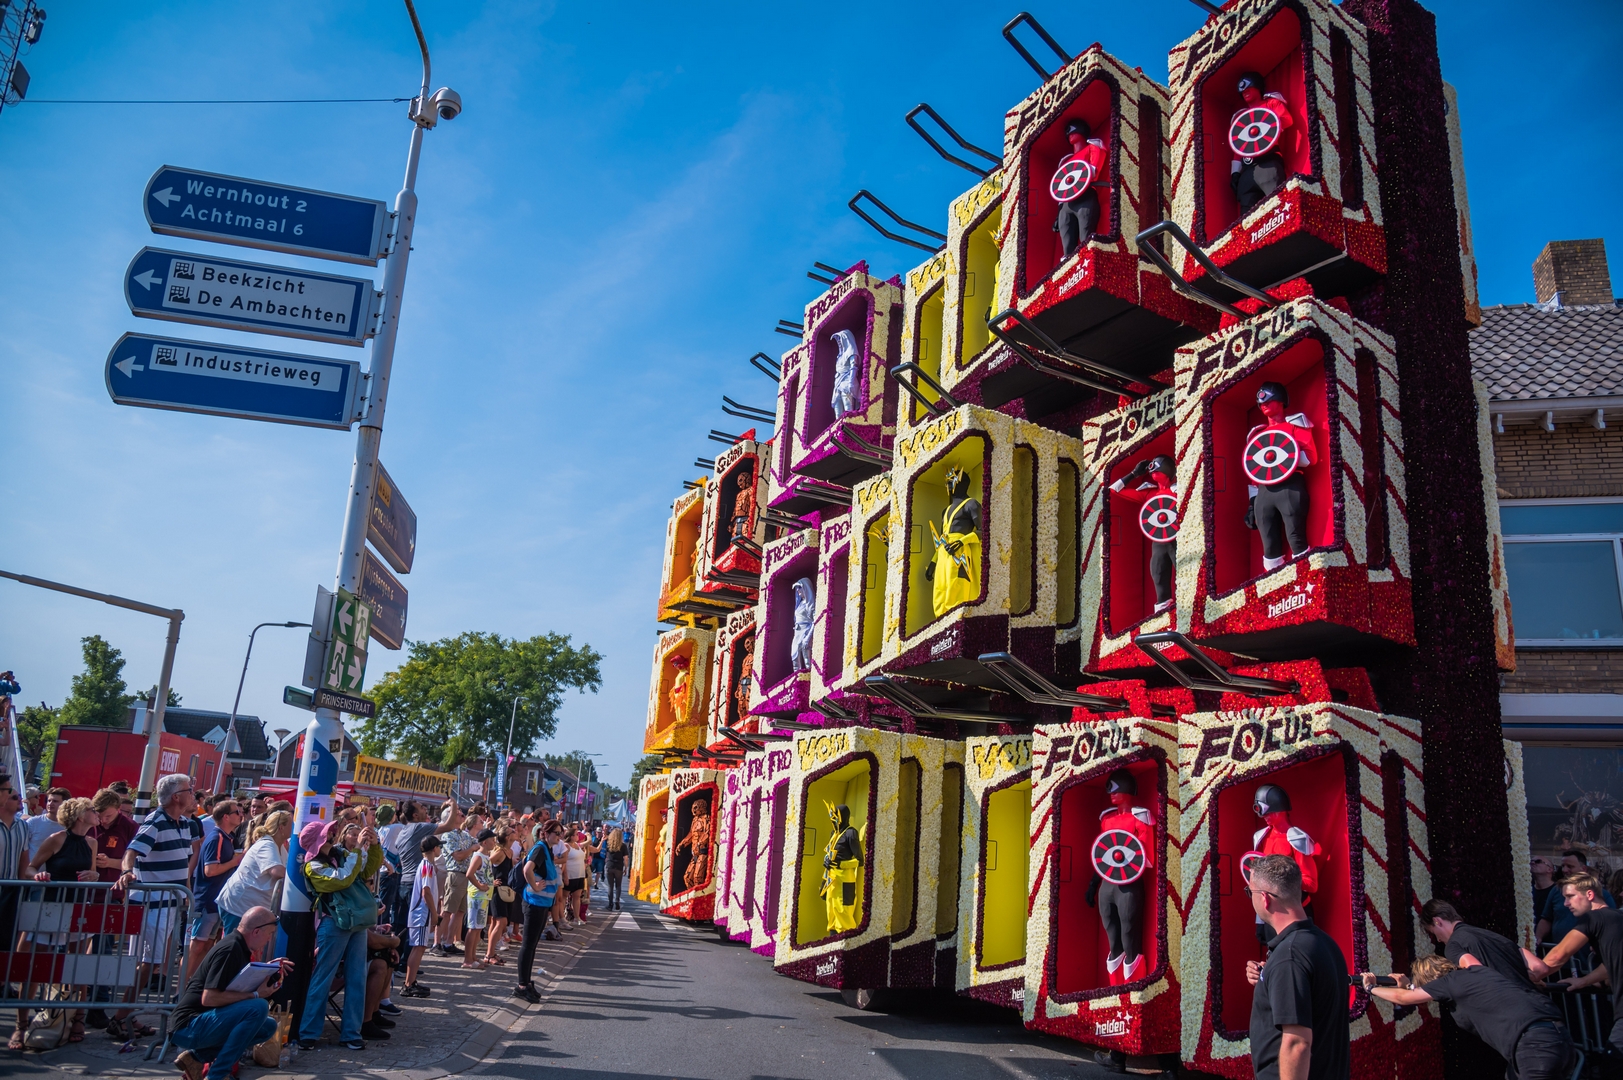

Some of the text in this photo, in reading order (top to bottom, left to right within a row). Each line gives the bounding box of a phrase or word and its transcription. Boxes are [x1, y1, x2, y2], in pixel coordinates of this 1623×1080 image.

[1012, 55, 1089, 148] FOCUS
[187, 179, 307, 212] Wernhout 2
[180, 203, 303, 236] Achtmaal 6
[1250, 212, 1285, 243] helden
[202, 266, 305, 295] Beekzicht
[198, 290, 346, 325] De Ambachten
[1187, 306, 1295, 396] FOCUS
[184, 352, 321, 386] Industrieweg
[1268, 593, 1306, 618] helden
[321, 693, 371, 715] PRINSENSTRAAT
[160, 751, 180, 772] EVENT
[1040, 726, 1131, 779] FOCUS
[1191, 713, 1313, 778] FOCUS
[1095, 1019, 1125, 1037] helden
